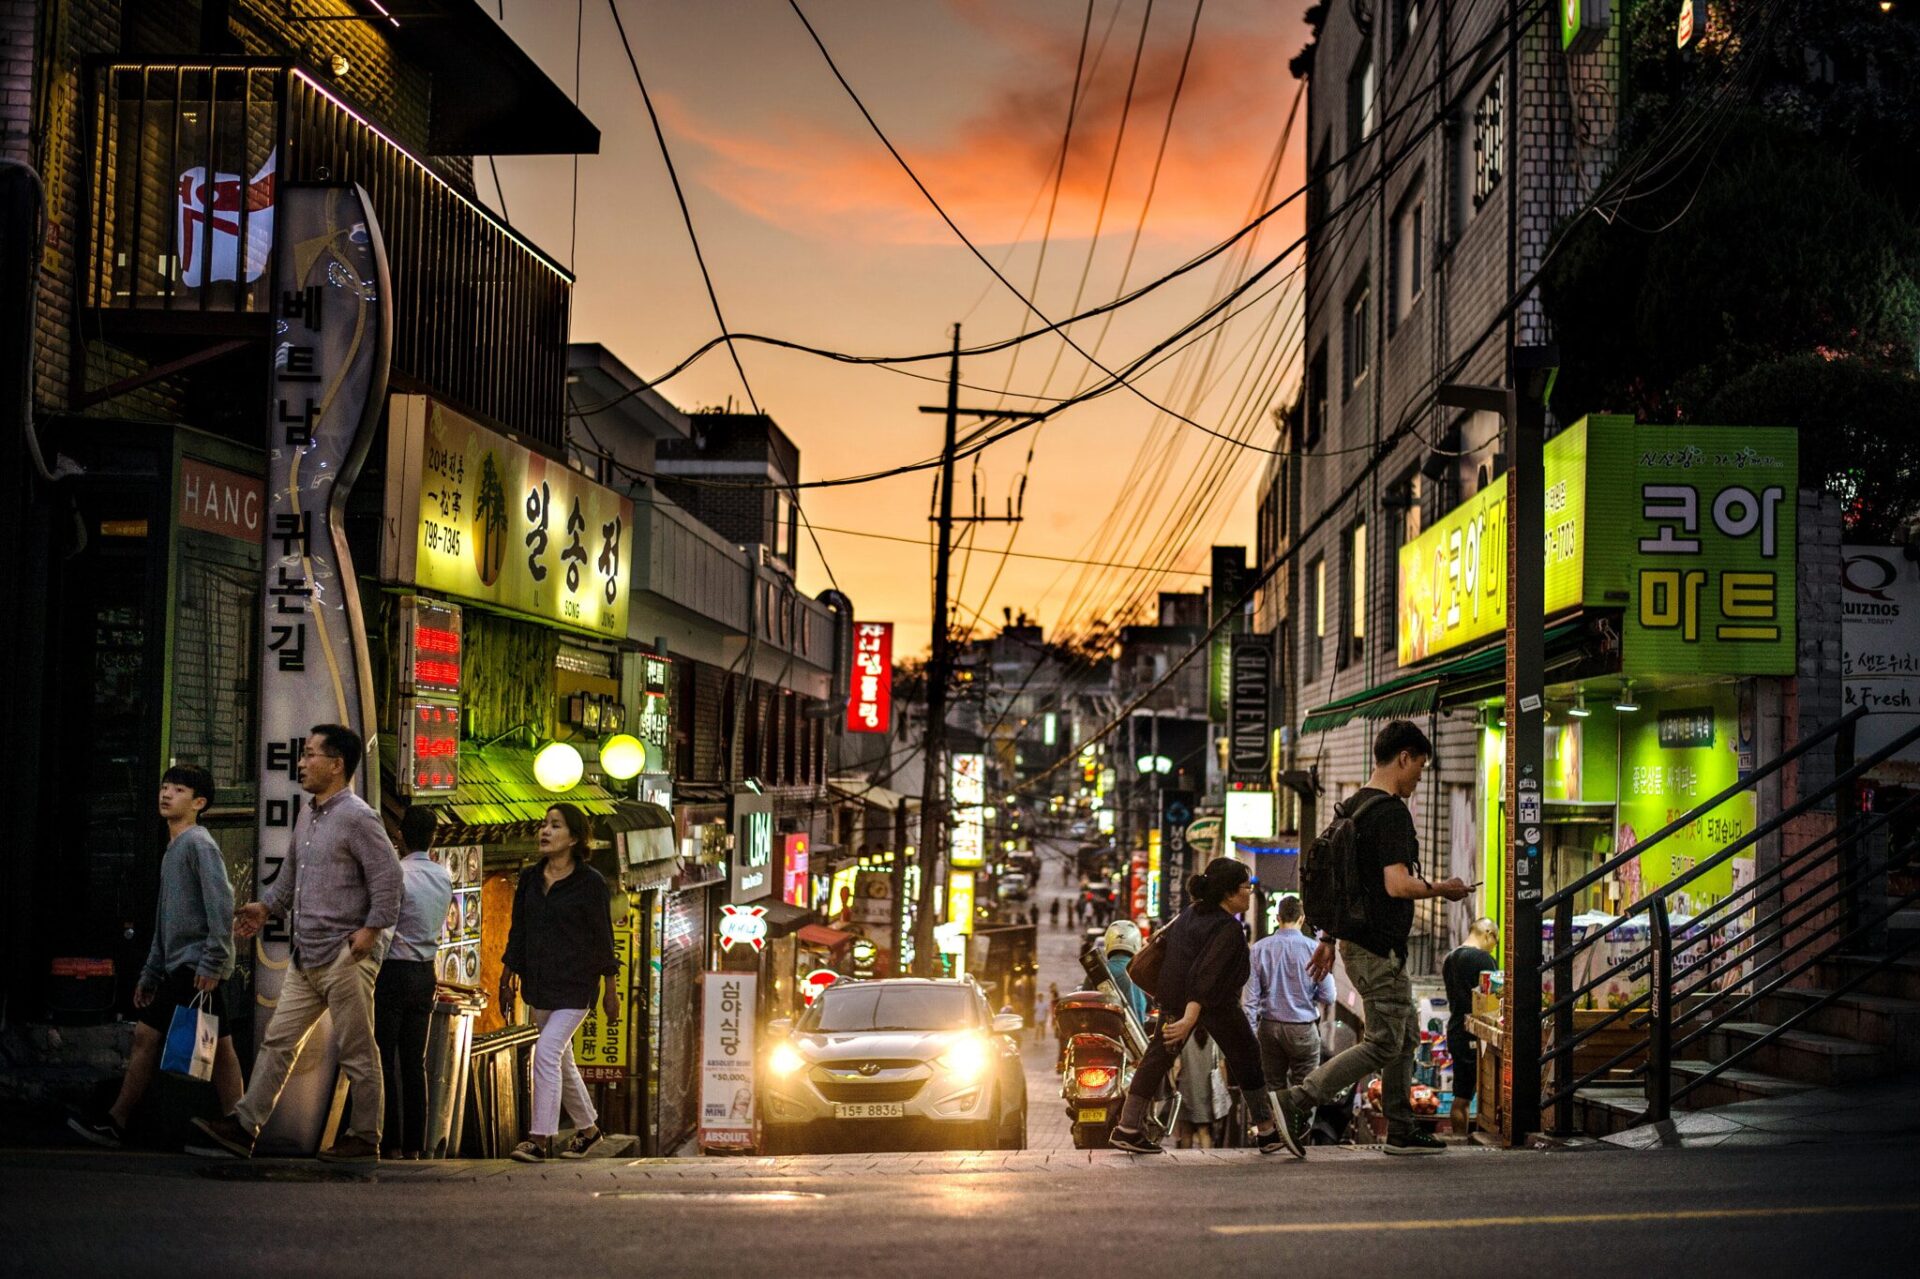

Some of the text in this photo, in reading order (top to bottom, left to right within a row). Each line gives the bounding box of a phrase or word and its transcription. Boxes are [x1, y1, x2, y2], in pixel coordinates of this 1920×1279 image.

[278, 285, 322, 446] 베트남
[428, 447, 466, 484] 20년전통
[185, 473, 258, 531] HANG
[427, 486, 464, 523] 一松亭
[1638, 484, 1787, 559] 코아
[423, 519, 462, 557] 798-7345
[526, 480, 622, 605] 일송정
[267, 510, 312, 672] 퀴논길
[563, 598, 580, 619] SONG
[600, 612, 615, 630] JUNG
[1638, 568, 1792, 643] 마트
[1236, 656, 1266, 761] HACIENDA
[1860, 686, 1912, 707] Fresh
[1520, 810, 1536, 821] 1-1
[720, 981, 742, 1056] 심야식당
[868, 1104, 897, 1116] 8836
[704, 1132, 749, 1144] ABSOLUT
